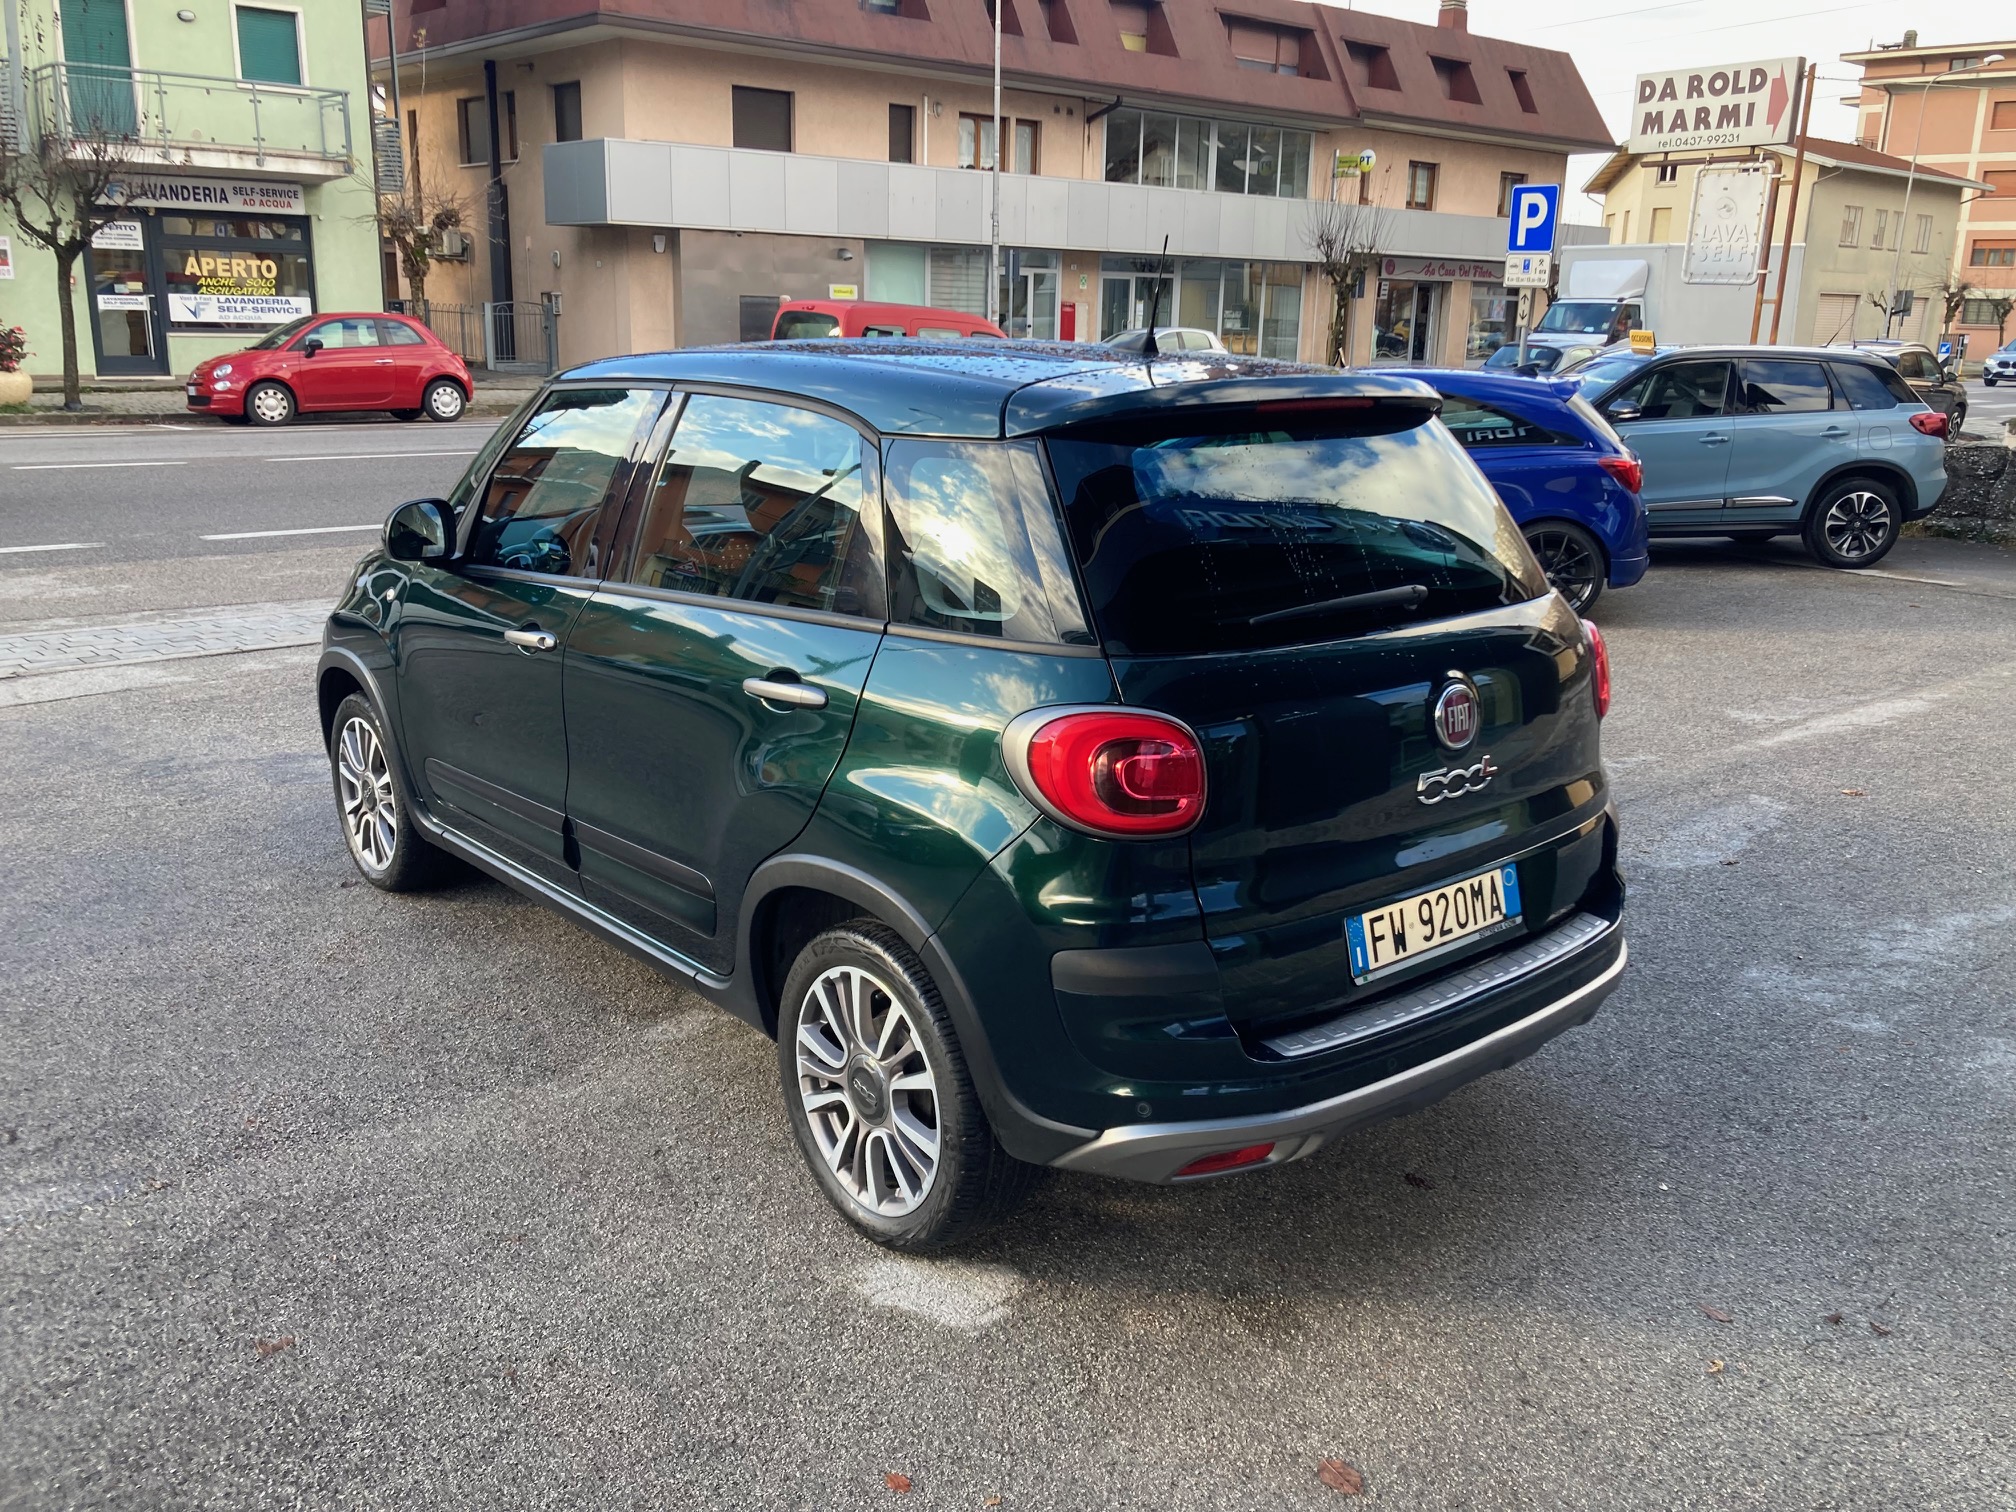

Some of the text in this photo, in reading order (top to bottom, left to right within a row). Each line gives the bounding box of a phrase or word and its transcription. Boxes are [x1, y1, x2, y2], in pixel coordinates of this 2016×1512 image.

[1638, 67, 1768, 105] DA ROLD
[1640, 102, 1756, 136] MARMI
[1658, 133, 1740, 149] tel.0437-99231
[232, 185, 299, 200] SELF-SERVICE
[242, 197, 293, 209] AD ACQUA
[1516, 192, 1548, 246] P
[1701, 224, 1749, 243] LAVA
[1700, 244, 1749, 262] SELF
[184, 256, 278, 279] APERTO
[197, 277, 276, 287] ANCHE SOLO
[198, 286, 276, 296] ASCIUGATURA
[216, 297, 291, 306] LAVANDERIA
[217, 305, 302, 315] SELF-SERVICE
[1447, 702, 1470, 734] FIAT
[1368, 874, 1503, 963] FW 920MA
